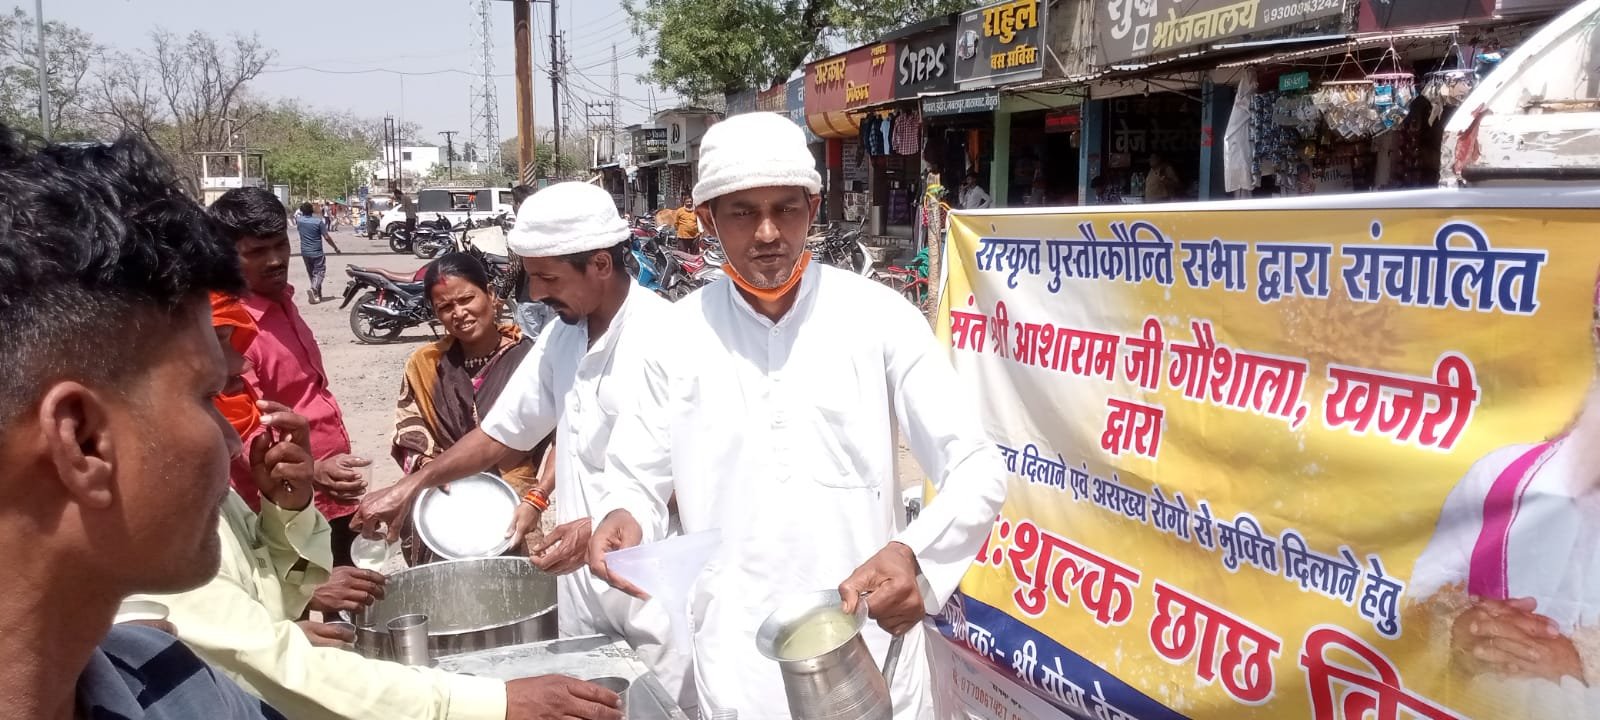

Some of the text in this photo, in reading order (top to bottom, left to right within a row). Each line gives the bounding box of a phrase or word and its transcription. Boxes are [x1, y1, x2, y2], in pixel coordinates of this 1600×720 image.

[982, 0, 1041, 44] राहुल
[1153, 0, 1261, 49] भोजनालय
[815, 57, 847, 85] सरकार
[900, 43, 945, 86] STEPS
[991, 44, 1037, 70] बस सर्विस
[976, 225, 1041, 288] संस्कृत
[1181, 240, 1246, 291] सभा
[1257, 245, 1330, 301] द्वारा
[1342, 222, 1546, 313] संचालित
[950, 295, 1477, 450] संत श्री आशाराम जी गौशाला, खजरी
[1101, 398, 1163, 458] द्वारा
[1021, 444, 1067, 489] दिलाने
[1070, 462, 1089, 500] एवं
[1093, 475, 1149, 522] असंख्य
[1194, 503, 1215, 548] से
[1219, 512, 1277, 569] मुक्ति
[1283, 533, 1359, 601] दिलाने
[1359, 554, 1402, 637] हेतु
[1152, 579, 1282, 703] छाछ
[1012, 640, 1038, 688] श्री
[1041, 657, 1089, 716] योग
